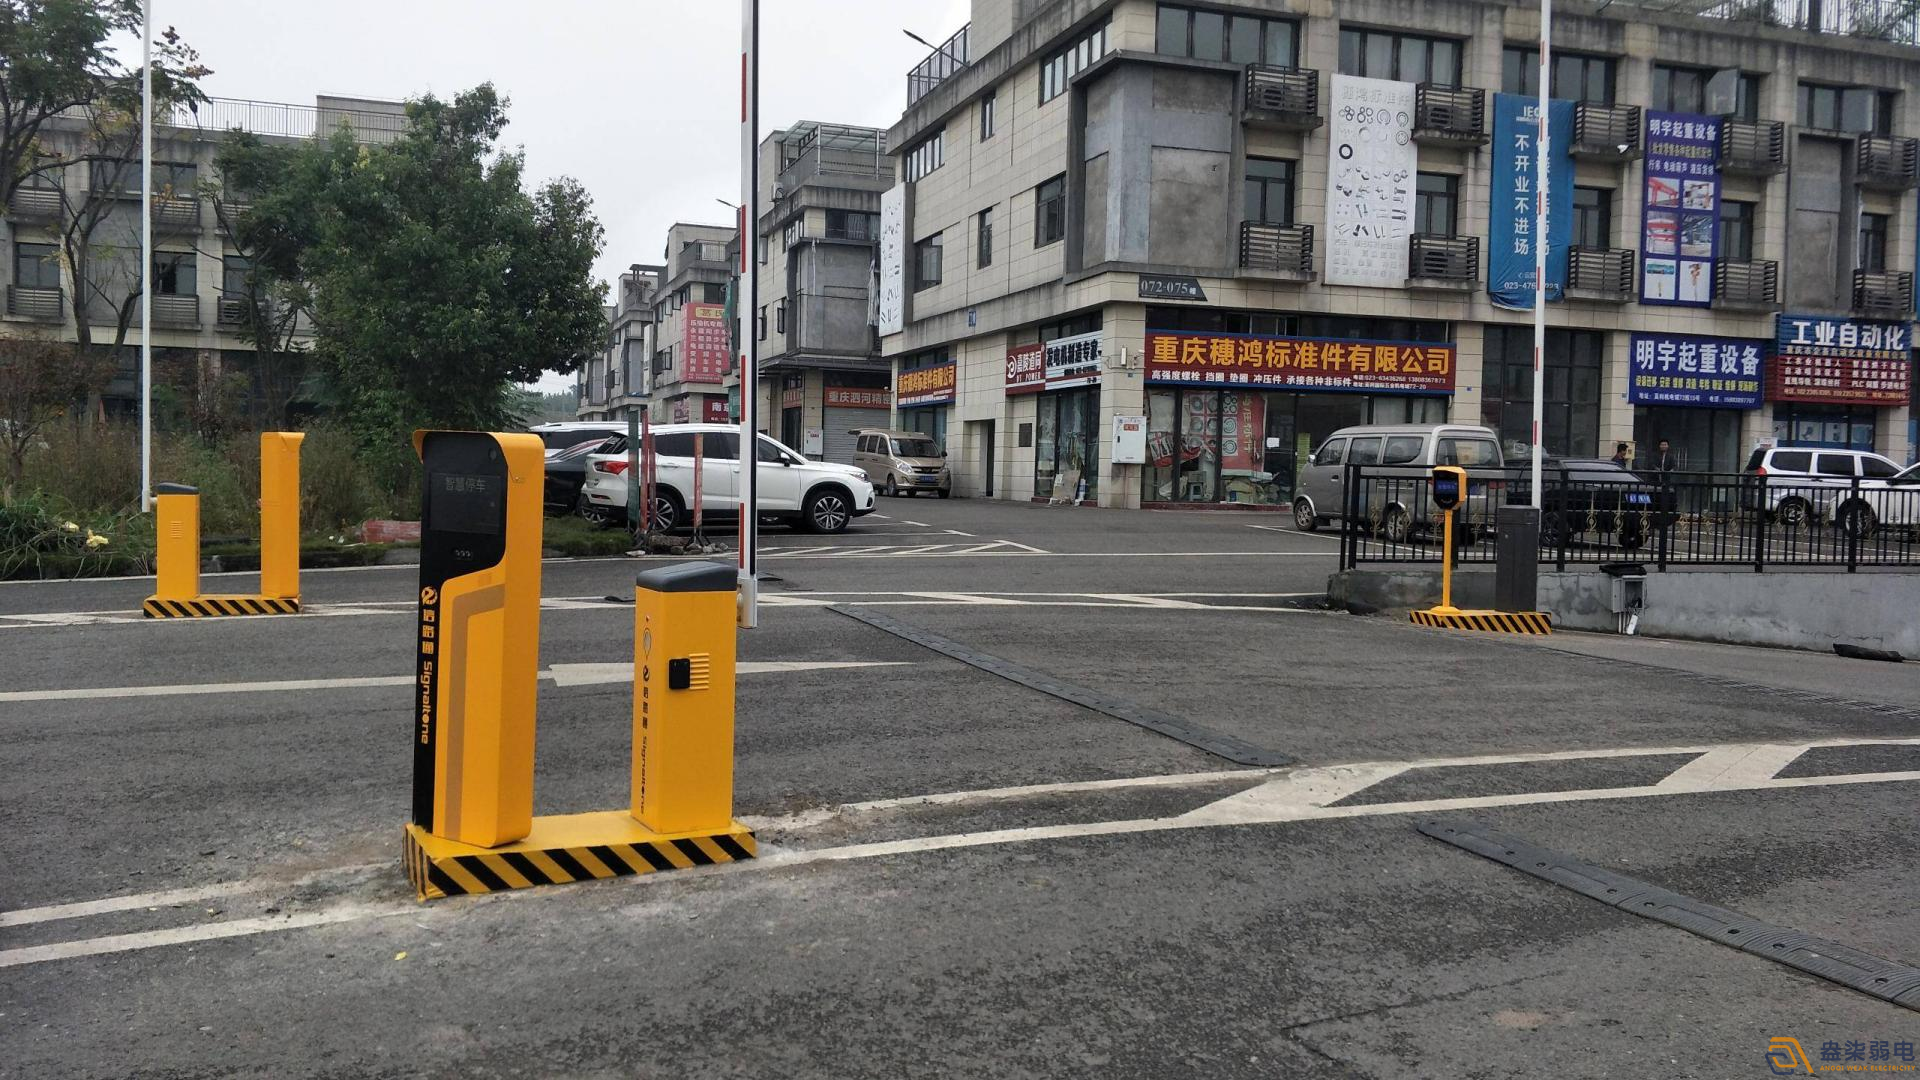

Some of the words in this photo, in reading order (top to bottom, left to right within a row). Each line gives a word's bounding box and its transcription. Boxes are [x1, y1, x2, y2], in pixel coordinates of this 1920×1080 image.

[1649, 119, 1716, 141] 明宇起重设备
[1514, 134, 1530, 256] 不开业不进场
[1790, 321, 1905, 350] 工业自动化
[1046, 339, 1098, 368] 发电机制造专家
[1152, 336, 1449, 375] 重庆穗鸿标准件有限公司
[1636, 340, 1759, 376] 明宇起重设备
[1151, 370, 1201, 381] 高强度螺栓
[1205, 372, 1224, 383] 挡圈
[1229, 373, 1248, 383] 垫圈
[1253, 374, 1282, 385] 冲压件
[1286, 375, 1351, 388] 承接各种非标件
